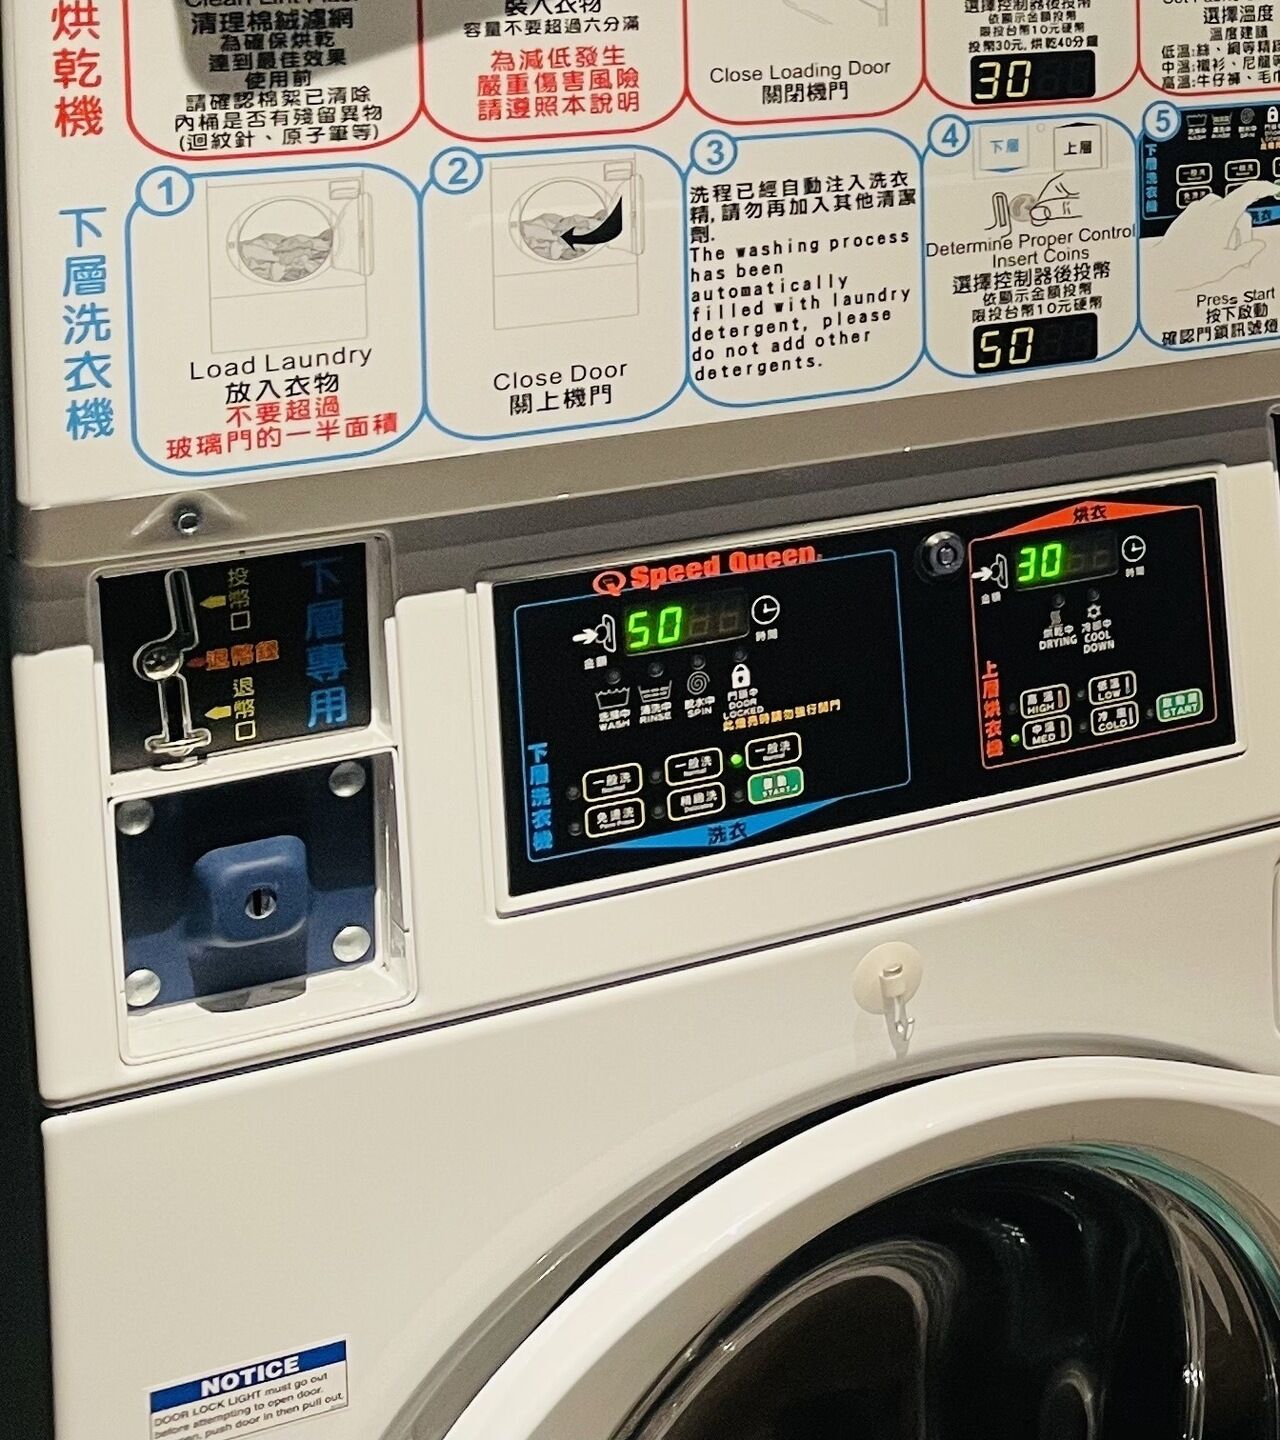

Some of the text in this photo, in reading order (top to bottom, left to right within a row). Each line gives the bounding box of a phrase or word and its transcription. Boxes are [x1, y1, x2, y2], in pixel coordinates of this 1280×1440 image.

[463, 16, 640, 37] 容量不要超過六分滿
[1203, 6, 1274, 24] 選擇溫度
[491, 46, 625, 71] 為減低發生
[710, 59, 890, 84] Close Loading Door
[244, 69, 312, 88] 使用前
[477, 68, 640, 96] 嚴重傷害風險
[975, 60, 1031, 100] 30
[478, 92, 640, 121] 請遵照本說明
[761, 82, 849, 105] 關閉機門
[689, 230, 910, 263] The washing process
[927, 225, 1135, 257] Determine Proper Control
[691, 261, 784, 282] has been
[992, 247, 1089, 268] Insert Coins
[691, 274, 848, 303] automatically
[1197, 288, 1276, 307] Press Start
[692, 287, 911, 322] filled with laundry
[59, 207, 115, 440] 下層洗衣機
[692, 308, 891, 343] detergent, please
[692, 328, 871, 362] do not add other
[978, 327, 1034, 368] 50
[190, 346, 372, 380] Load Laundry
[493, 361, 628, 392] Close Door
[694, 357, 824, 382] detergents.
[225, 373, 340, 405] 放入衣物
[509, 384, 613, 416] 關上機門
[226, 397, 340, 426] 不要超過
[166, 412, 398, 460] 玻璃門的一半面積
[631, 545, 816, 590] Speed Queen
[1018, 543, 1062, 582] 30
[627, 606, 682, 648] 50
[1084, 630, 1110, 642] COOL
[1039, 634, 1077, 651] DRYING
[1083, 641, 1114, 654] DOWN
[729, 698, 757, 709] DOOR
[1027, 702, 1055, 715] HIGH
[1098, 689, 1120, 700] LOW
[639, 711, 672, 724] RINSE
[687, 704, 712, 717] SPIN
[1163, 702, 1198, 717] START
[598, 719, 630, 730] WASH
[1032, 733, 1056, 744] MED
[1098, 718, 1126, 732] COLD
[201, 1355, 299, 1397] NOTICE
[155, 1373, 328, 1426] DOOR LOCK LIGHT must go out
[235, 1416, 260, 1429] door
[264, 1412, 273, 1421] in
[276, 1405, 299, 1417] then
[303, 1397, 321, 1411] pull
